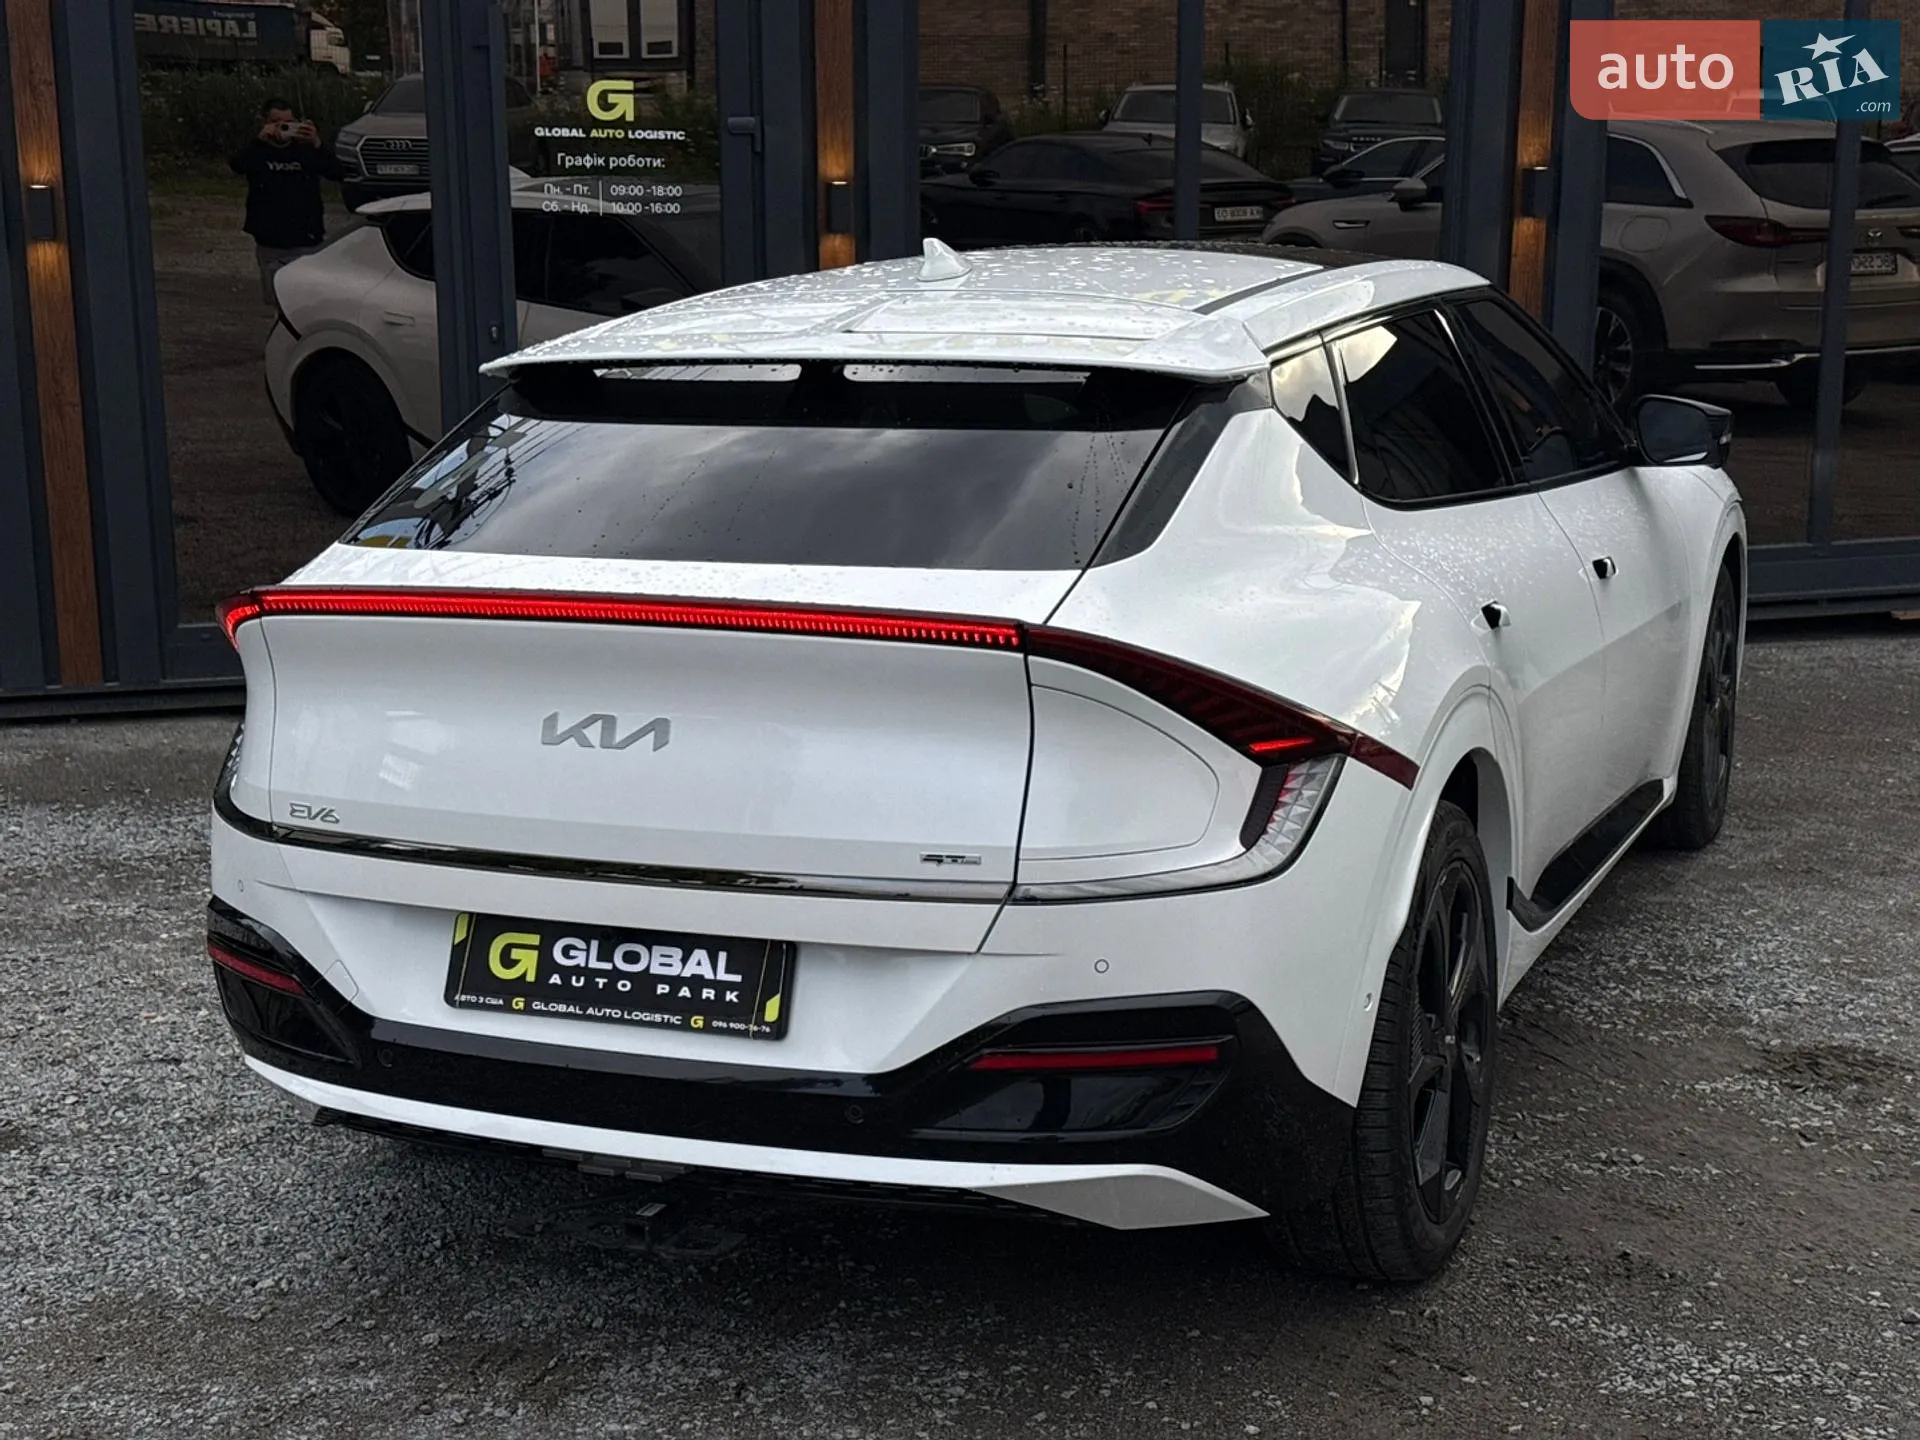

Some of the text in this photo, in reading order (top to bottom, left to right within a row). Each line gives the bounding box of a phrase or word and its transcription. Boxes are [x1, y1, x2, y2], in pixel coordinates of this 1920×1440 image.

[534, 127, 686, 141] GLOBAL AUTO LOGISTIC
[557, 153, 666, 169] Графік роботи:
[610, 184, 644, 196] 09:00
[611, 202, 642, 213] 10:00
[289, 802, 340, 824] EV6
[552, 937, 743, 983] GLOBAL
[549, 973, 740, 1003] AUTO PARK
[532, 1001, 683, 1025] GLOBAL AUTO LOGISTIC
